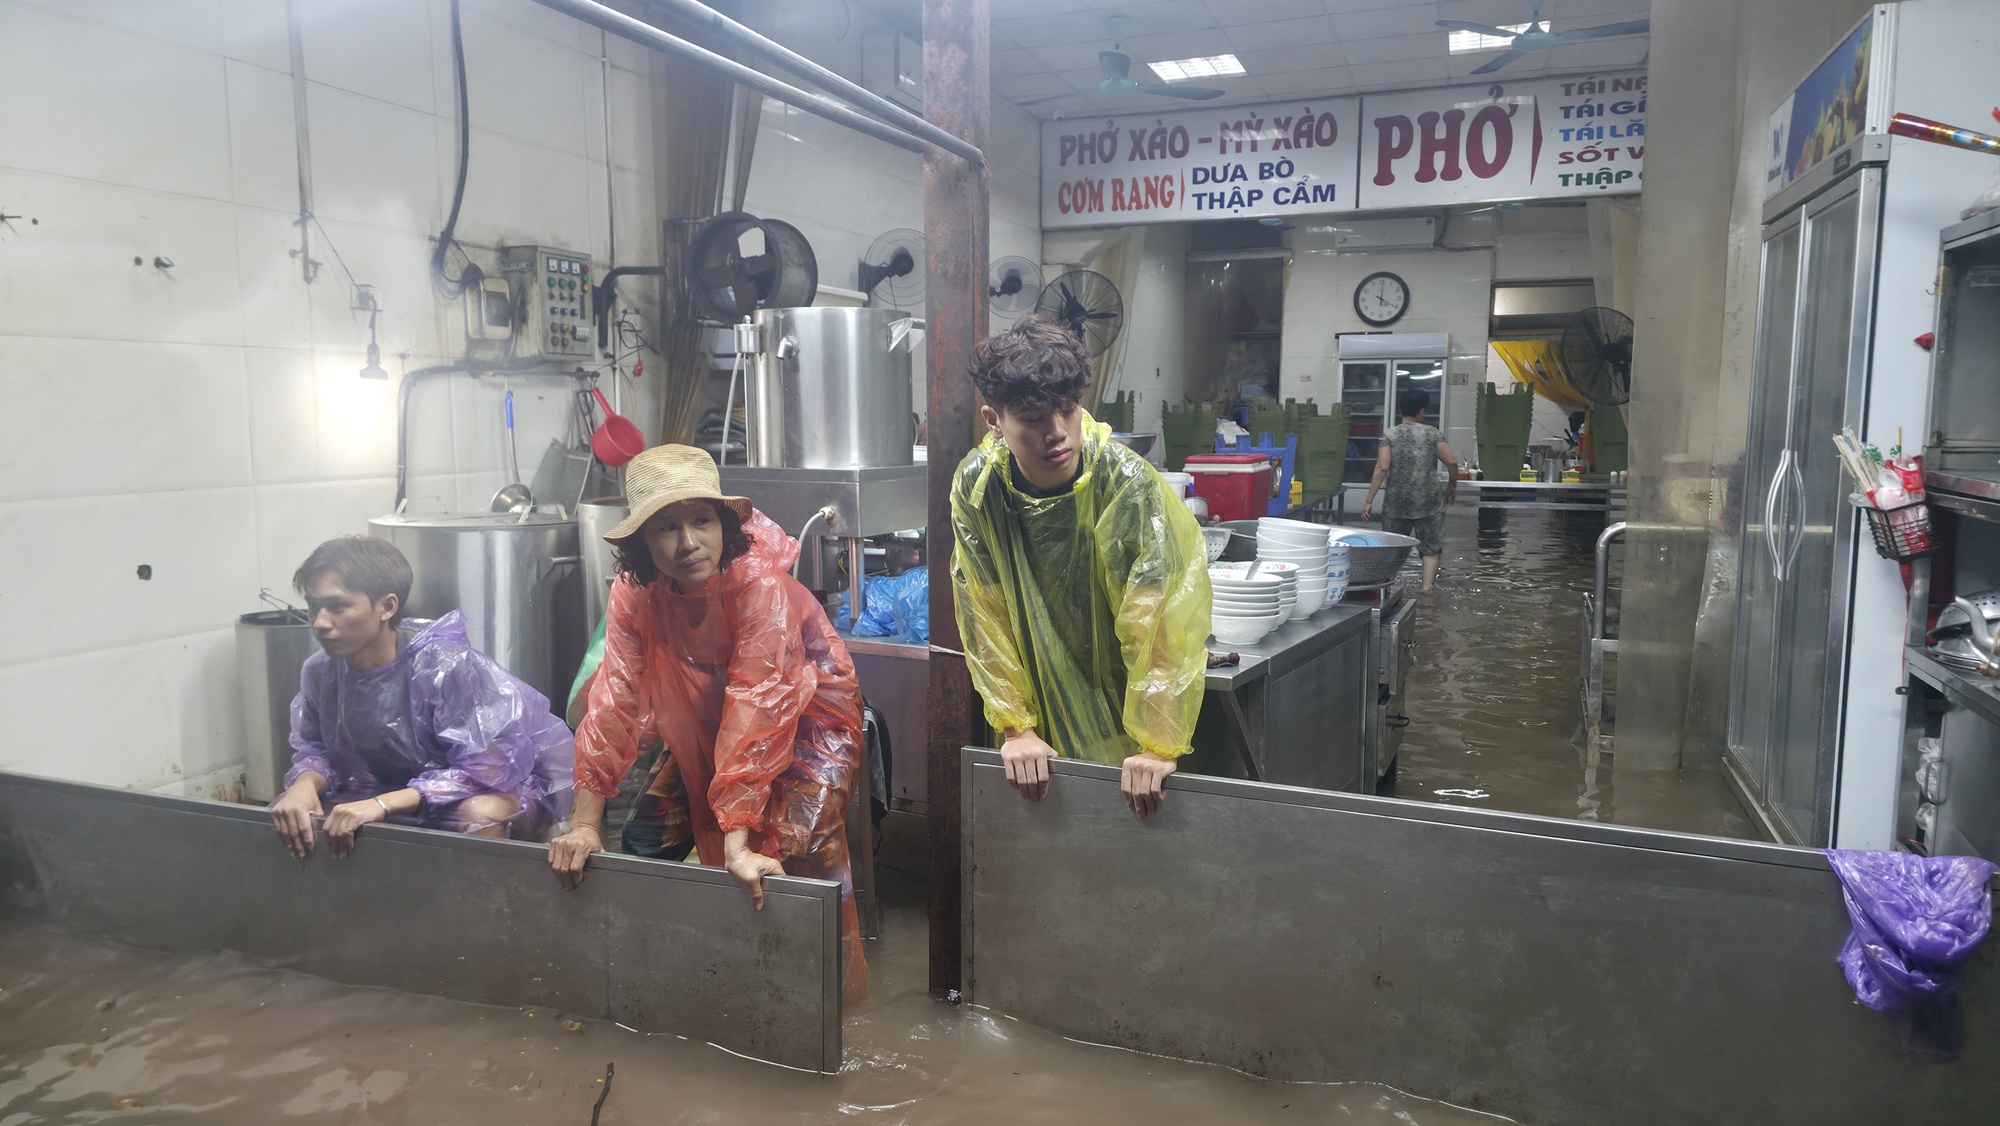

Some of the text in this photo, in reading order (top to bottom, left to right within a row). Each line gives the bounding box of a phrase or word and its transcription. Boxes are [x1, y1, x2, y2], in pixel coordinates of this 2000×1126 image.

[1560, 76, 1606, 96] TÁI
[1559, 98, 1604, 119] TÁI
[1060, 119, 1120, 167] PHỞ
[1127, 119, 1190, 162] XÀO
[1220, 112, 1264, 155] MỲ
[1272, 107, 1338, 151] XÀO
[1373, 84, 1519, 186] PHỞ
[1559, 121, 1604, 142] TÁI
[1558, 141, 1620, 165] SỐT
[1192, 156, 1295, 185] DƯA BÒ
[1558, 167, 1634, 190] THẬP
[1058, 174, 1175, 215] CƠM RANG
[1191, 174, 1336, 214] THẬP CẨM
